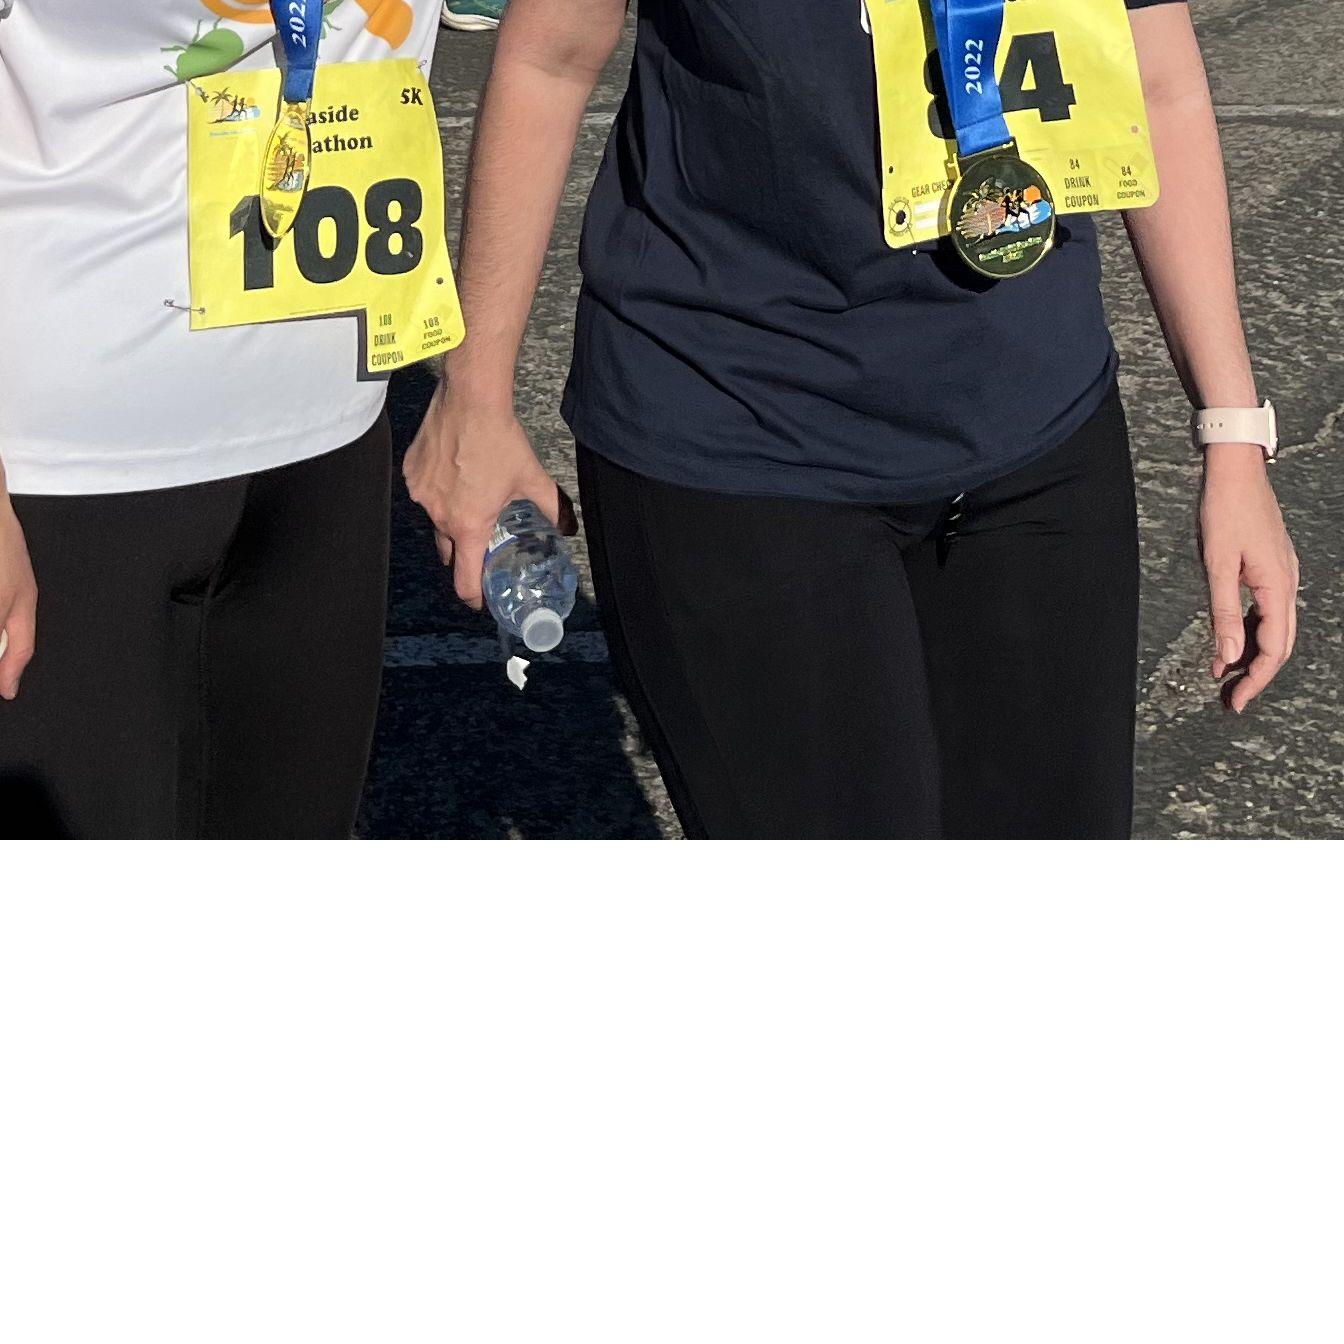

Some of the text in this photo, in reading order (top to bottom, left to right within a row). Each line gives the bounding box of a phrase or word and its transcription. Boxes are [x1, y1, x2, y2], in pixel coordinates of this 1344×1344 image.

[965, 39, 983, 95] 2022
[400, 87, 424, 106] 5K
[306, 105, 359, 124] aside
[312, 135, 373, 154] athon
[1069, 158, 1080, 170] 84
[1121, 166, 1132, 176] 84
[911, 180, 950, 197] GEAR CHE
[1064, 176, 1091, 189] DRINK
[1065, 194, 1099, 208] COUPON
[1117, 190, 1145, 199] COUPON
[229, 178, 423, 291] 108
[379, 314, 392, 326] 108
[423, 316, 439, 329] 108
[374, 332, 396, 346] DRINK
[422, 336, 451, 350] COUPON
[371, 351, 404, 366] COUPON
